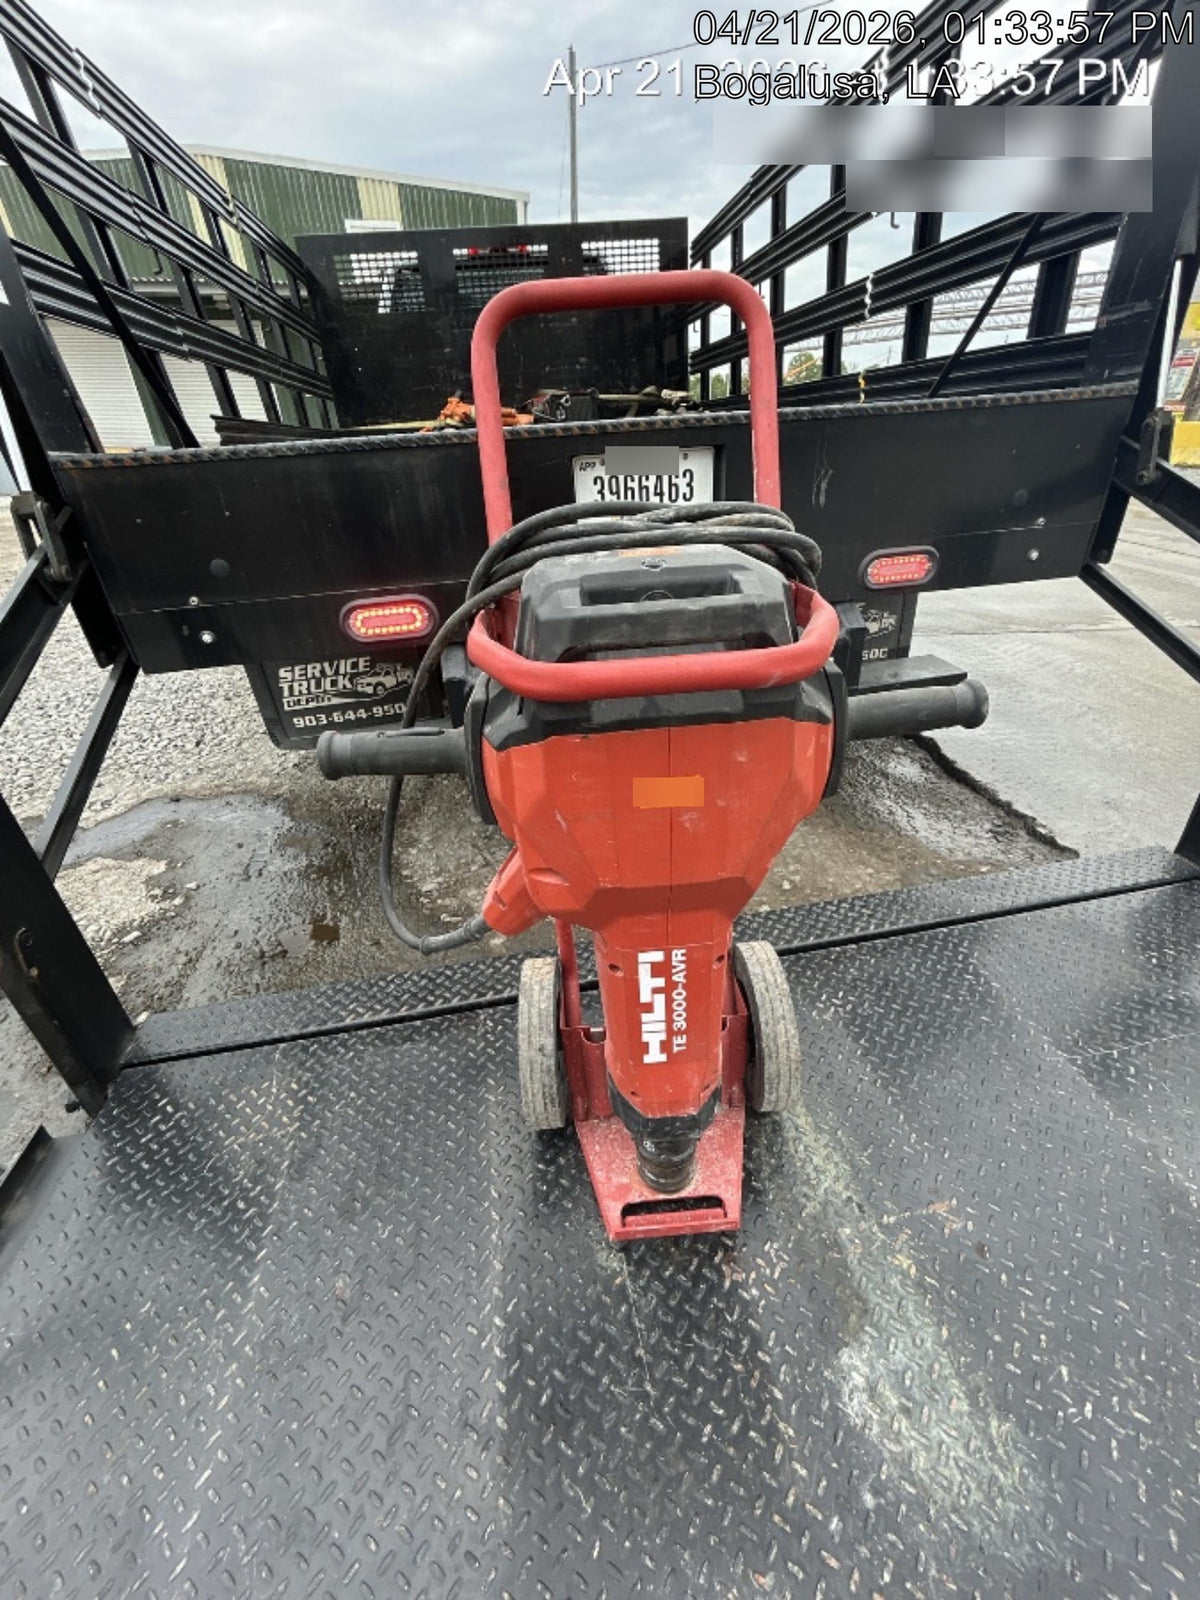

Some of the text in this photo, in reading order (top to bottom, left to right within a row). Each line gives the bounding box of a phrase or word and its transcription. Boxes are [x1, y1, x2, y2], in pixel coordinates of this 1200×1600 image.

[278, 656, 371, 682] SERVICE
[278, 674, 353, 698] TRUCK
[637, 950, 668, 1064] HILTI
[671, 948, 688, 1054] TE 3000-AVR
